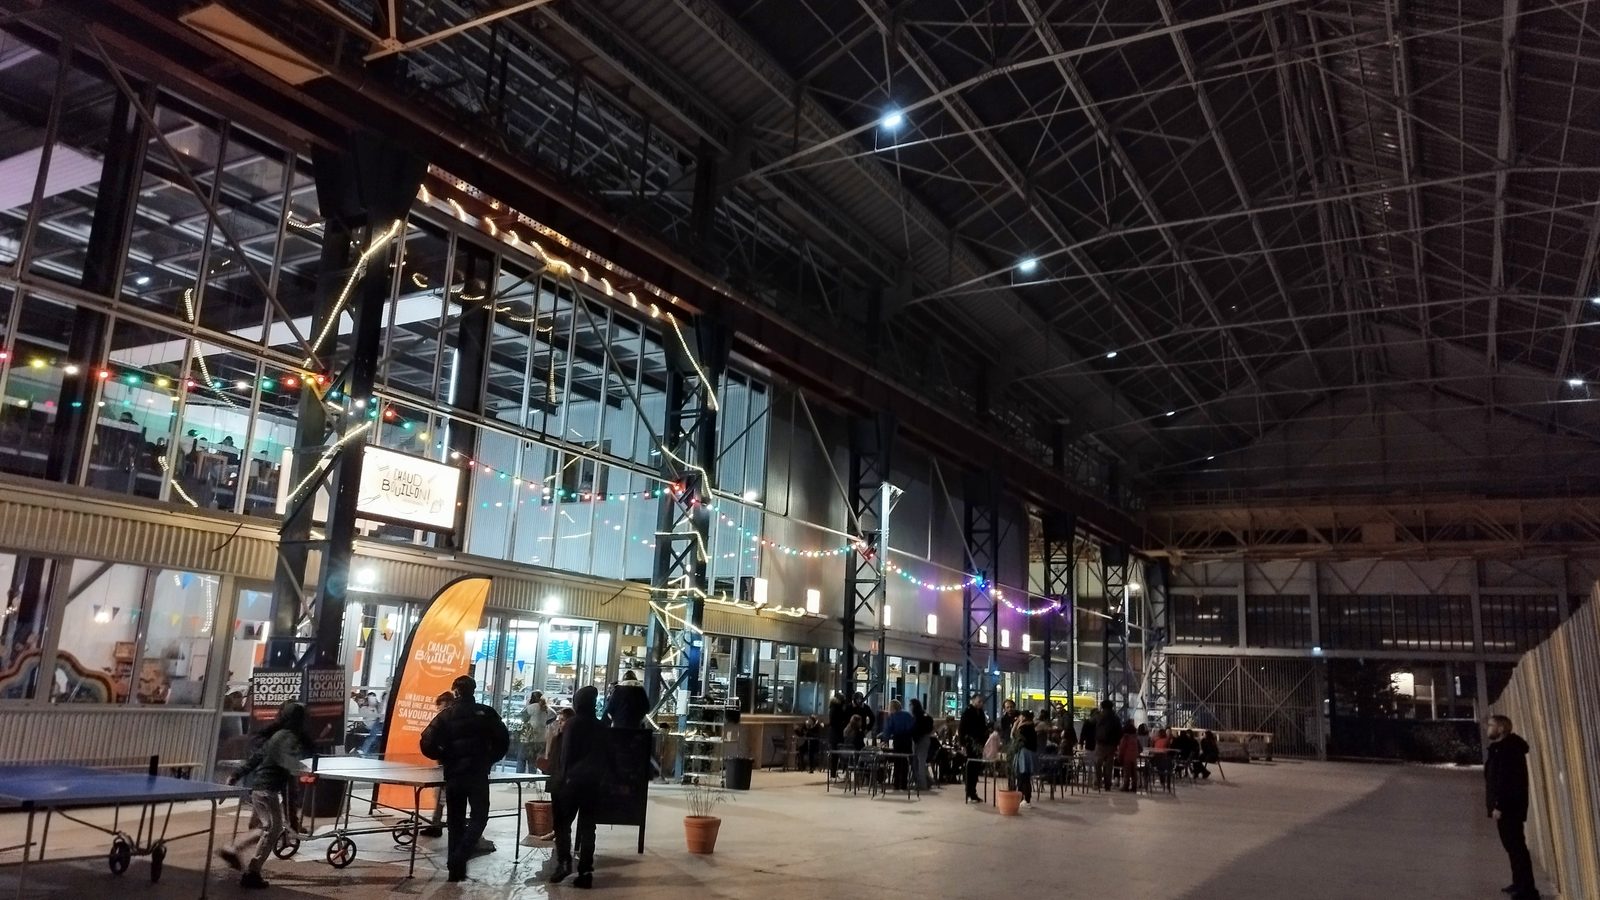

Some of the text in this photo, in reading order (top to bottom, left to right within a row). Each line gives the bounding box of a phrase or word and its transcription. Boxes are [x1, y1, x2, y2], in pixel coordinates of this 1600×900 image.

[393, 468, 423, 486] CHAUD
[253, 677, 302, 685] PRODUITS
[309, 673, 345, 682] PRODUITS
[253, 684, 301, 694] LOCAUX
[309, 681, 345, 690] LOCAUX
[253, 693, 266, 701] EN
[267, 693, 301, 701] DIRECT
[308, 689, 344, 698] EN DIRECT
